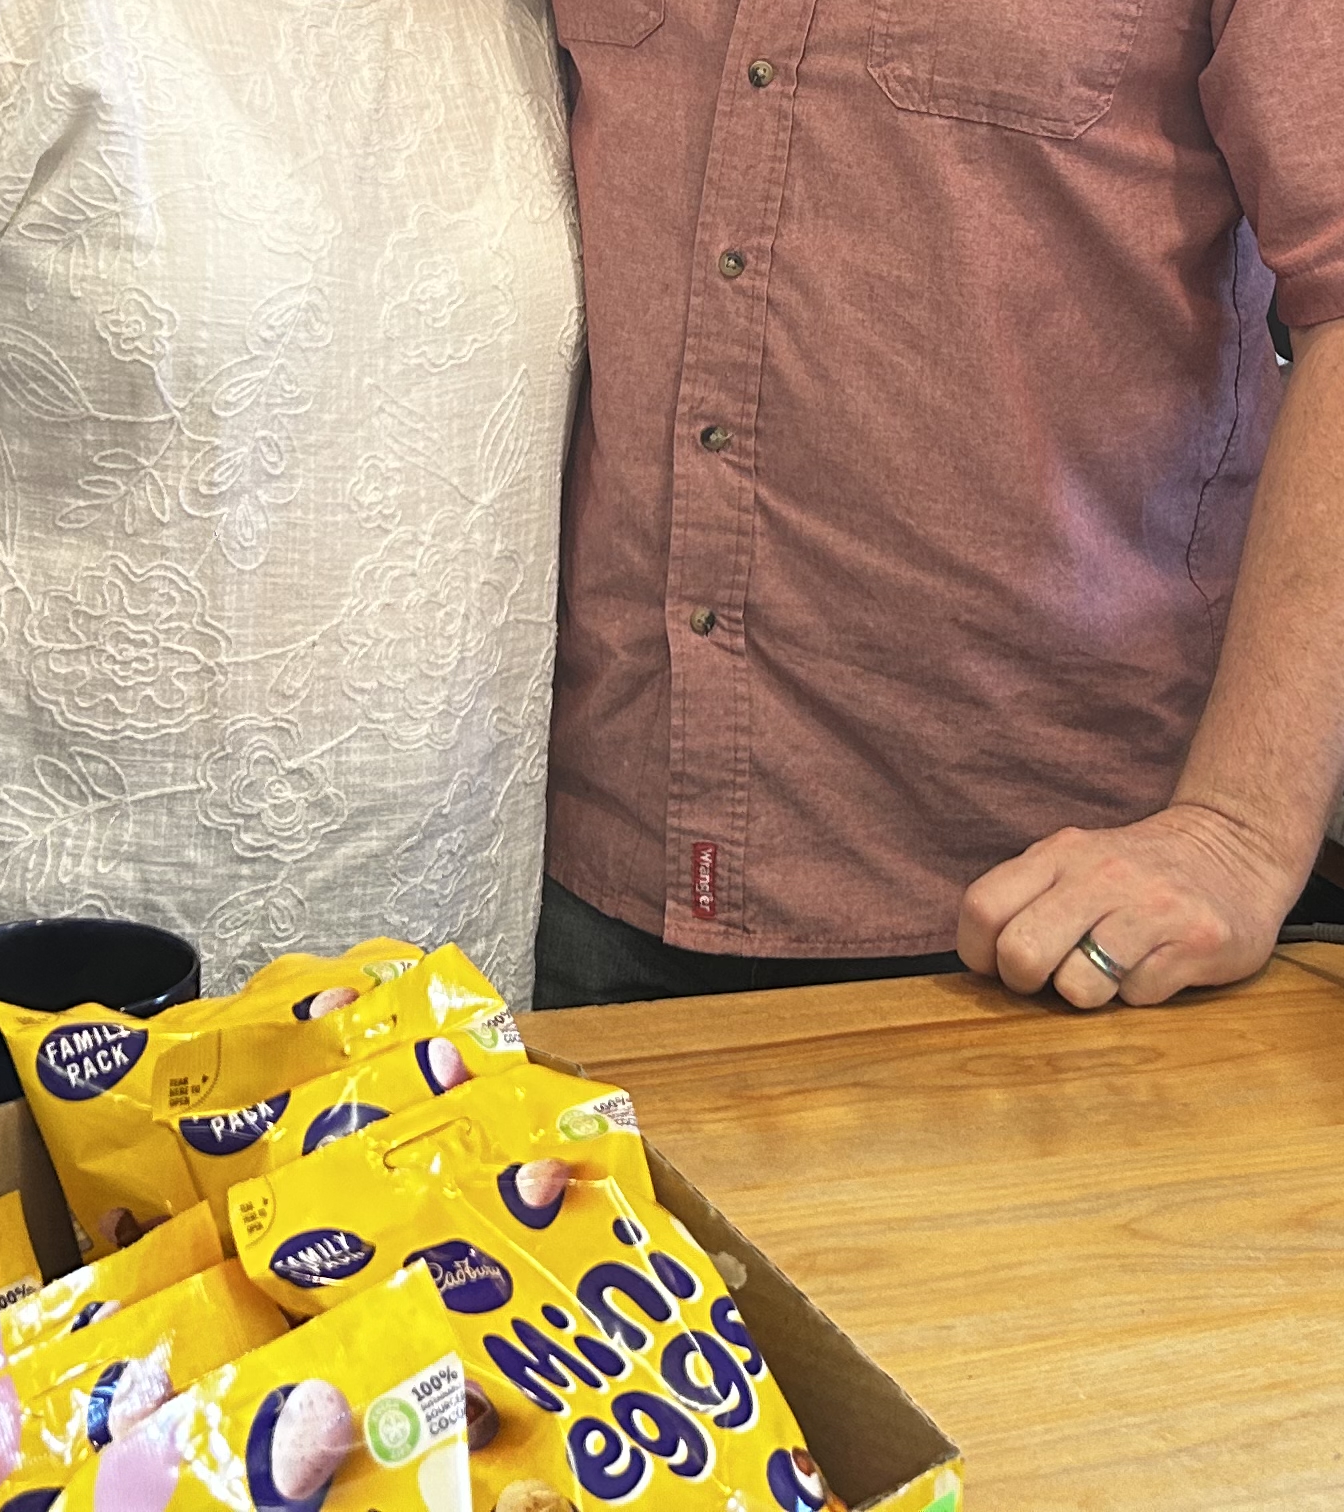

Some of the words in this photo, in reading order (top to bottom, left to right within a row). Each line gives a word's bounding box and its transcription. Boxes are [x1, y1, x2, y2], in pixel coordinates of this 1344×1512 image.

[66, 1043, 130, 1088] PACK
[209, 1099, 275, 1141] PACK
[430, 1254, 505, 1289] Cadbury
[482, 1216, 698, 1413] Mini
[410, 1365, 459, 1402] 100%
[566, 1295, 765, 1500] eggs
